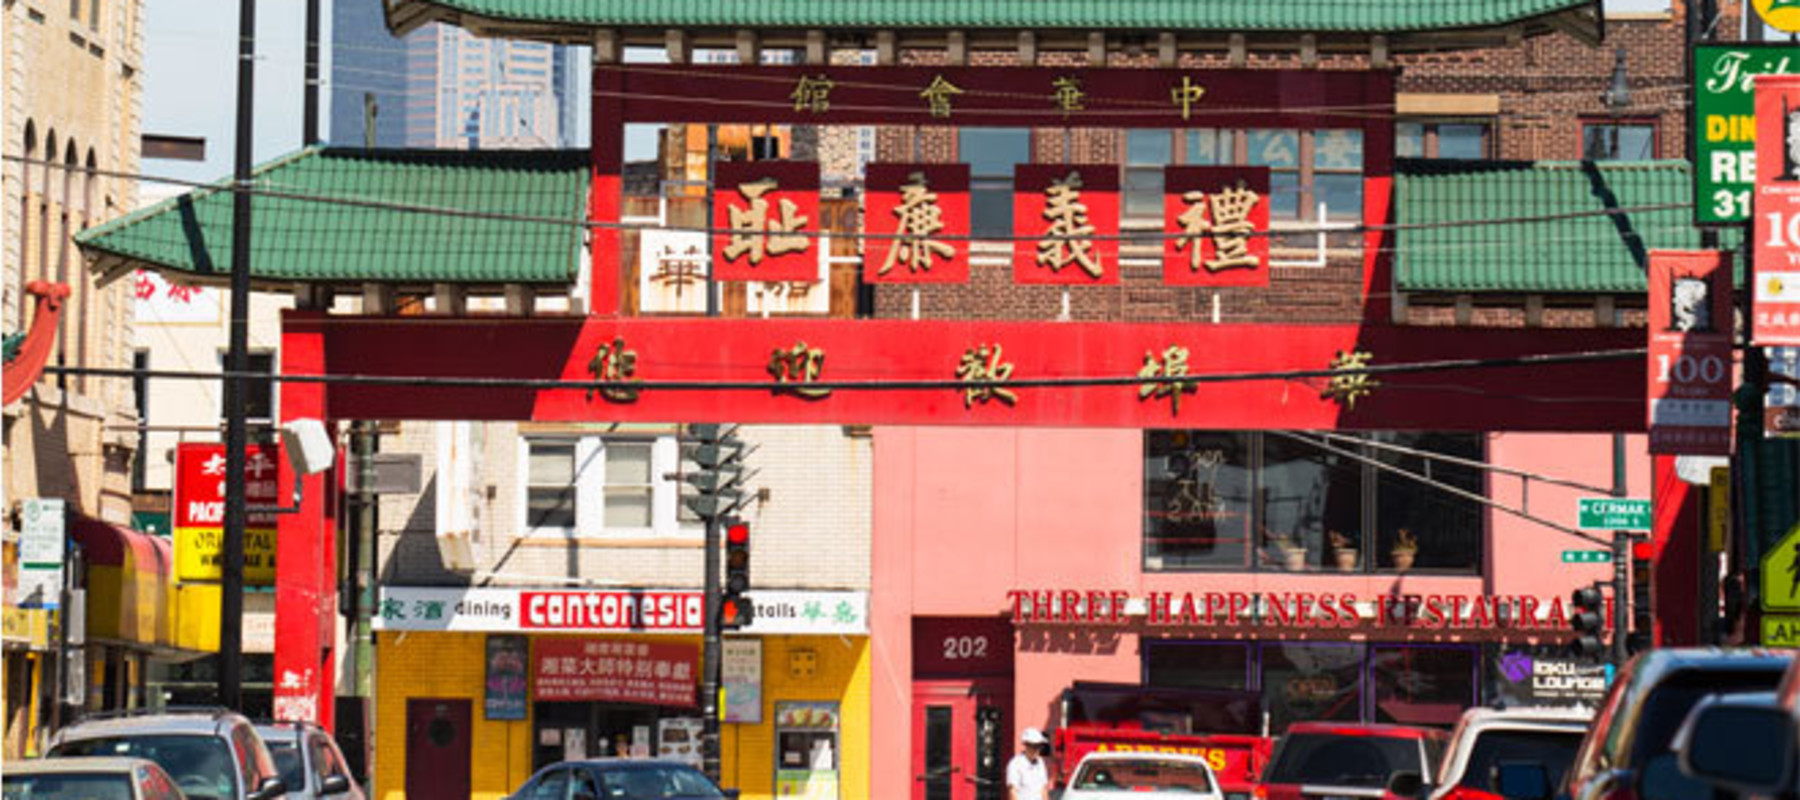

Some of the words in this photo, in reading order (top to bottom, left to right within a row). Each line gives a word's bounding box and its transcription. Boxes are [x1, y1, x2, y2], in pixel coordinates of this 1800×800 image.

[1656, 354, 1723, 383] 100
[454, 597, 511, 619] dining
[529, 592, 703, 626] cantonesia
[1006, 590, 1130, 624] THREE
[1146, 592, 1360, 627] HAPPINESS
[1376, 594, 1616, 630] RESTAURAT
[944, 636, 989, 659] 202
